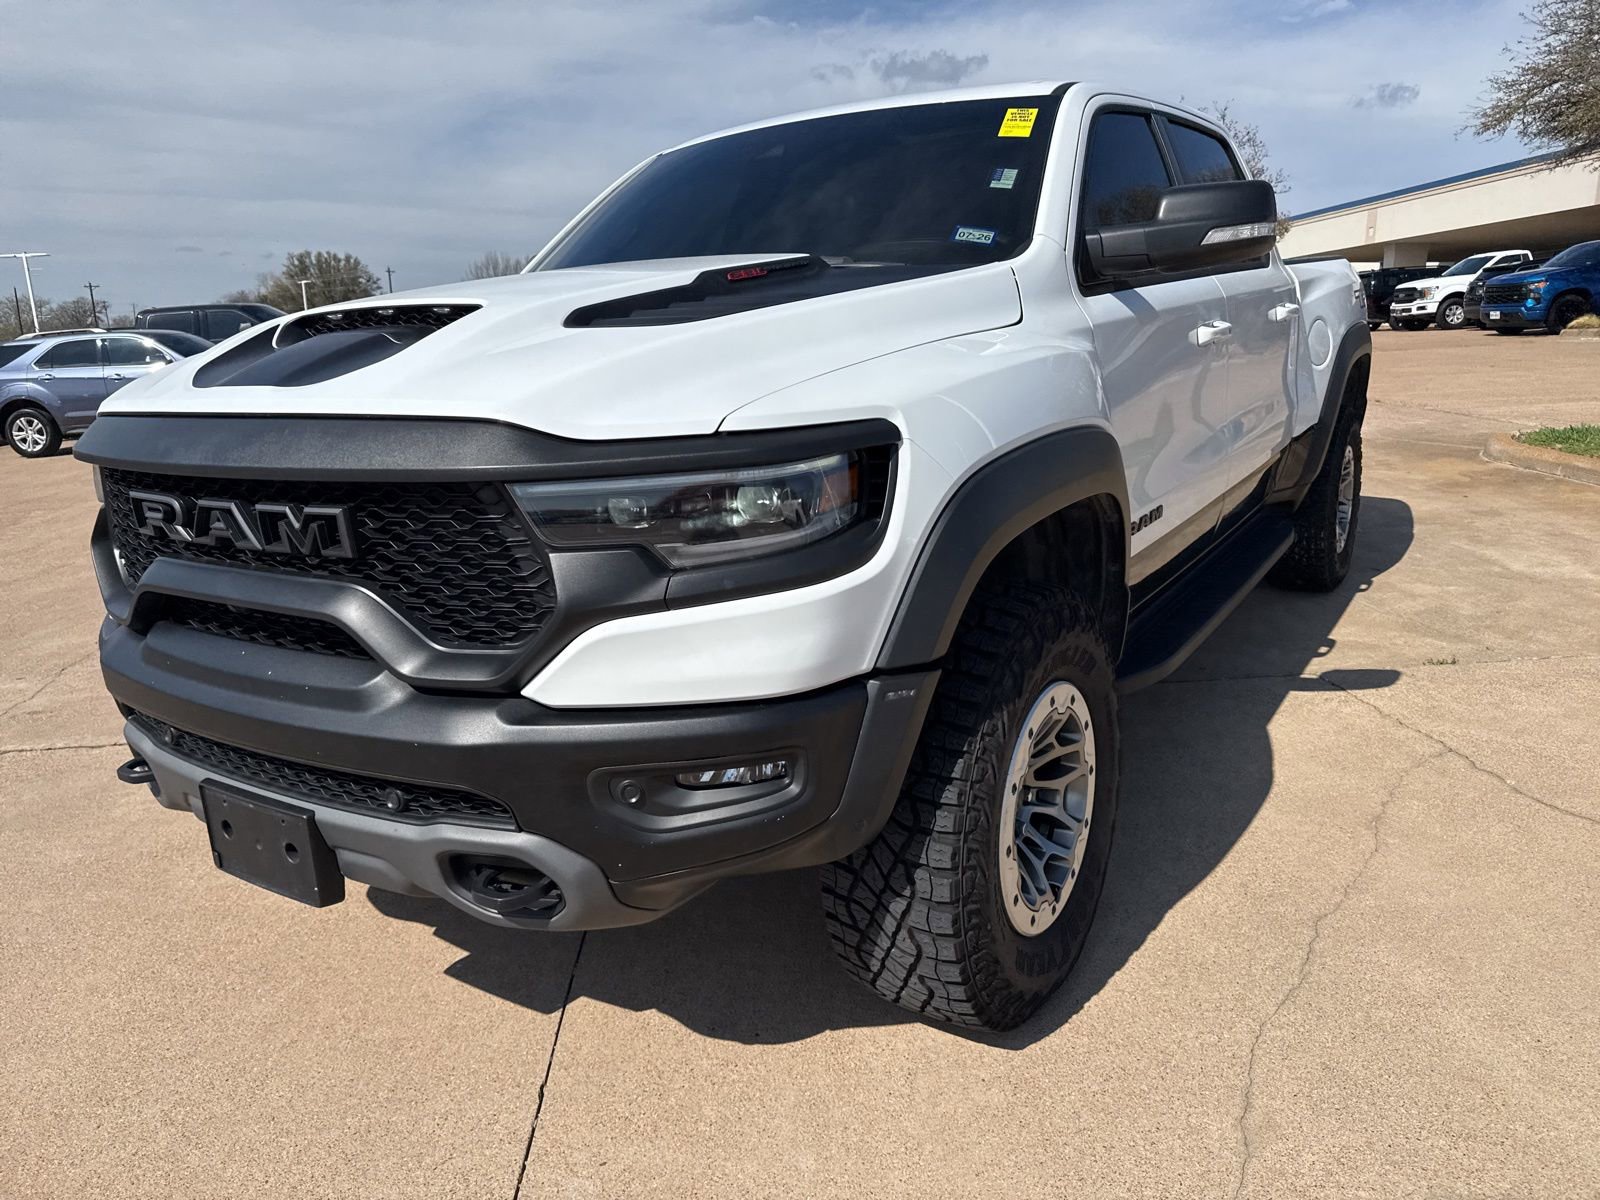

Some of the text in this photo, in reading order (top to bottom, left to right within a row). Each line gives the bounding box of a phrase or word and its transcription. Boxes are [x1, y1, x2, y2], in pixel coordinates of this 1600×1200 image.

[958, 231, 991, 241] 07 26
[129, 490, 357, 559] RAM
